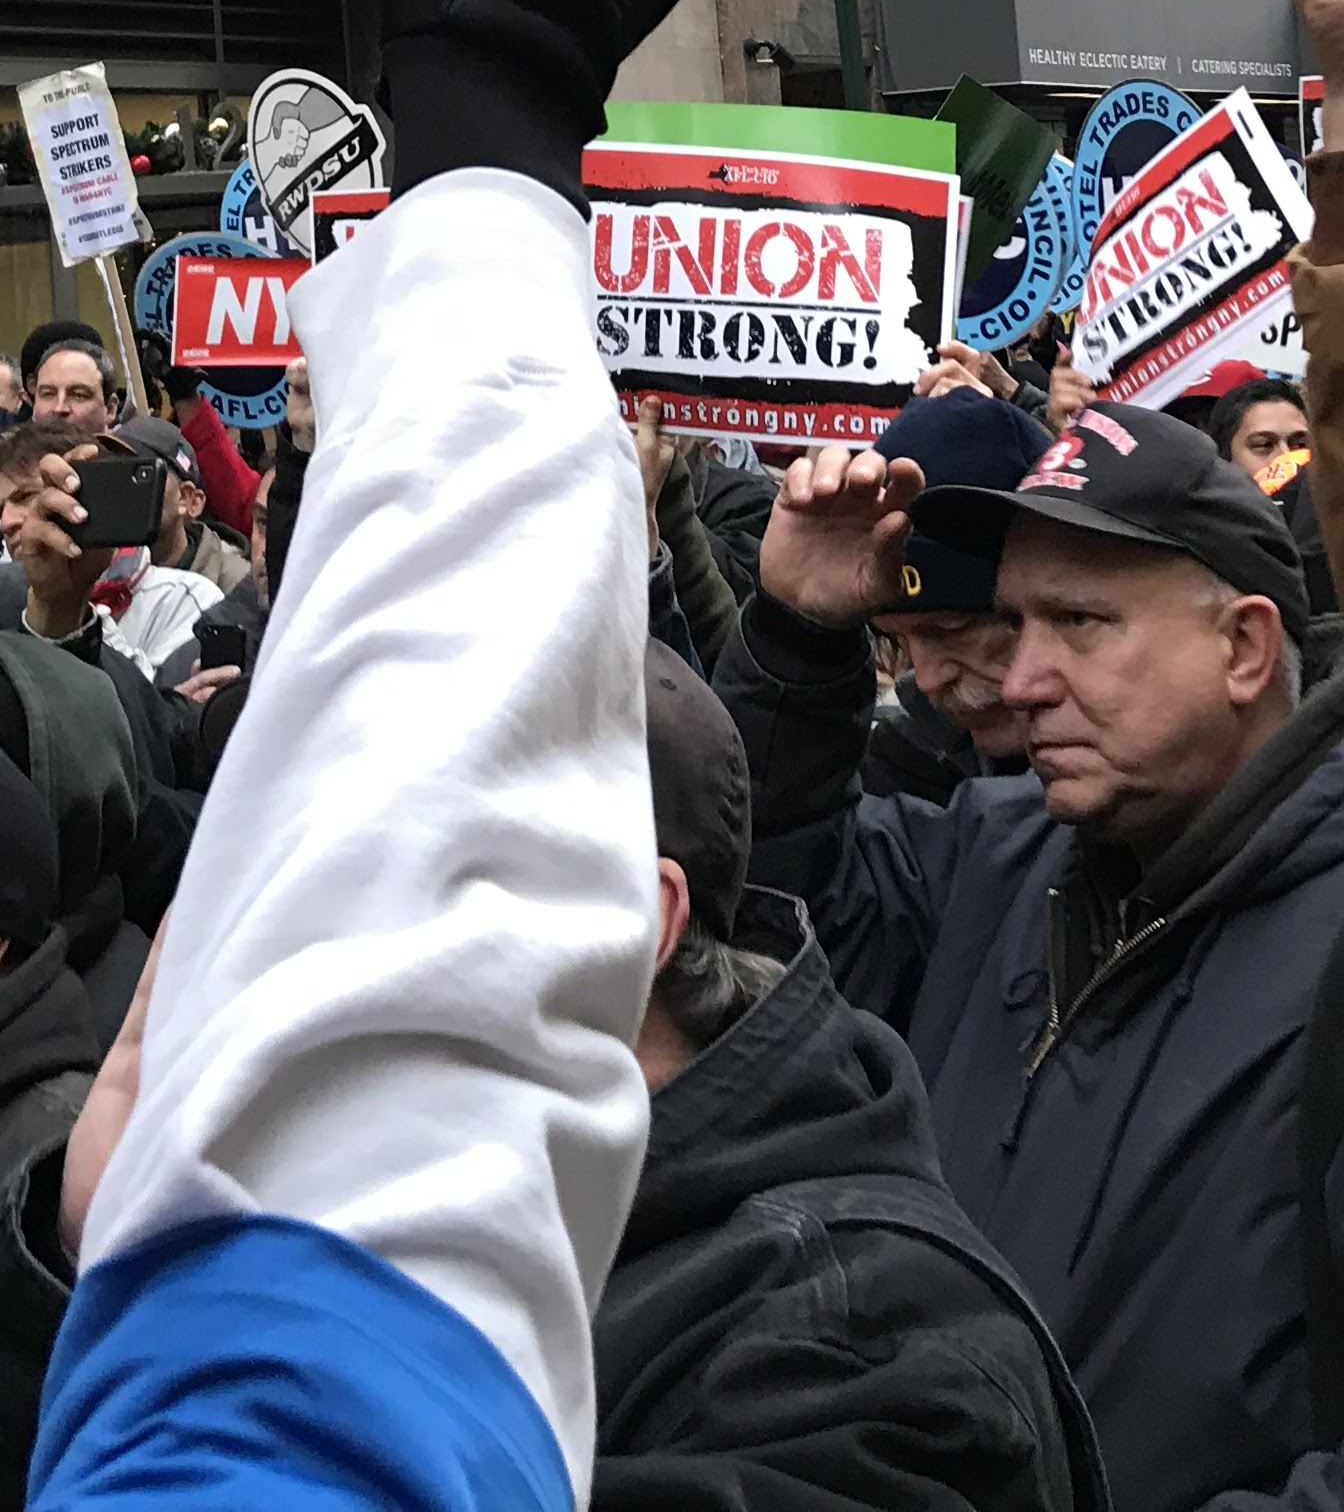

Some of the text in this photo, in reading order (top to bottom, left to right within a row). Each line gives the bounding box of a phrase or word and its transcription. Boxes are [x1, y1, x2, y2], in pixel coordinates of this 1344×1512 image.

[1028, 48, 1167, 72] HEALTHY ECLECTIC EATERY
[1191, 58, 1293, 78] CATERING SPECIALISTS
[50, 113, 100, 139] SUPPORT
[1089, 89, 1170, 150] TRADES
[50, 133, 110, 162] SPECTRUM
[59, 154, 112, 180] STRIKERS
[278, 135, 363, 224] RWDSU
[594, 212, 884, 304] UNION
[1081, 219, 1254, 362] STRONG!
[596, 304, 881, 370] STRONG!
